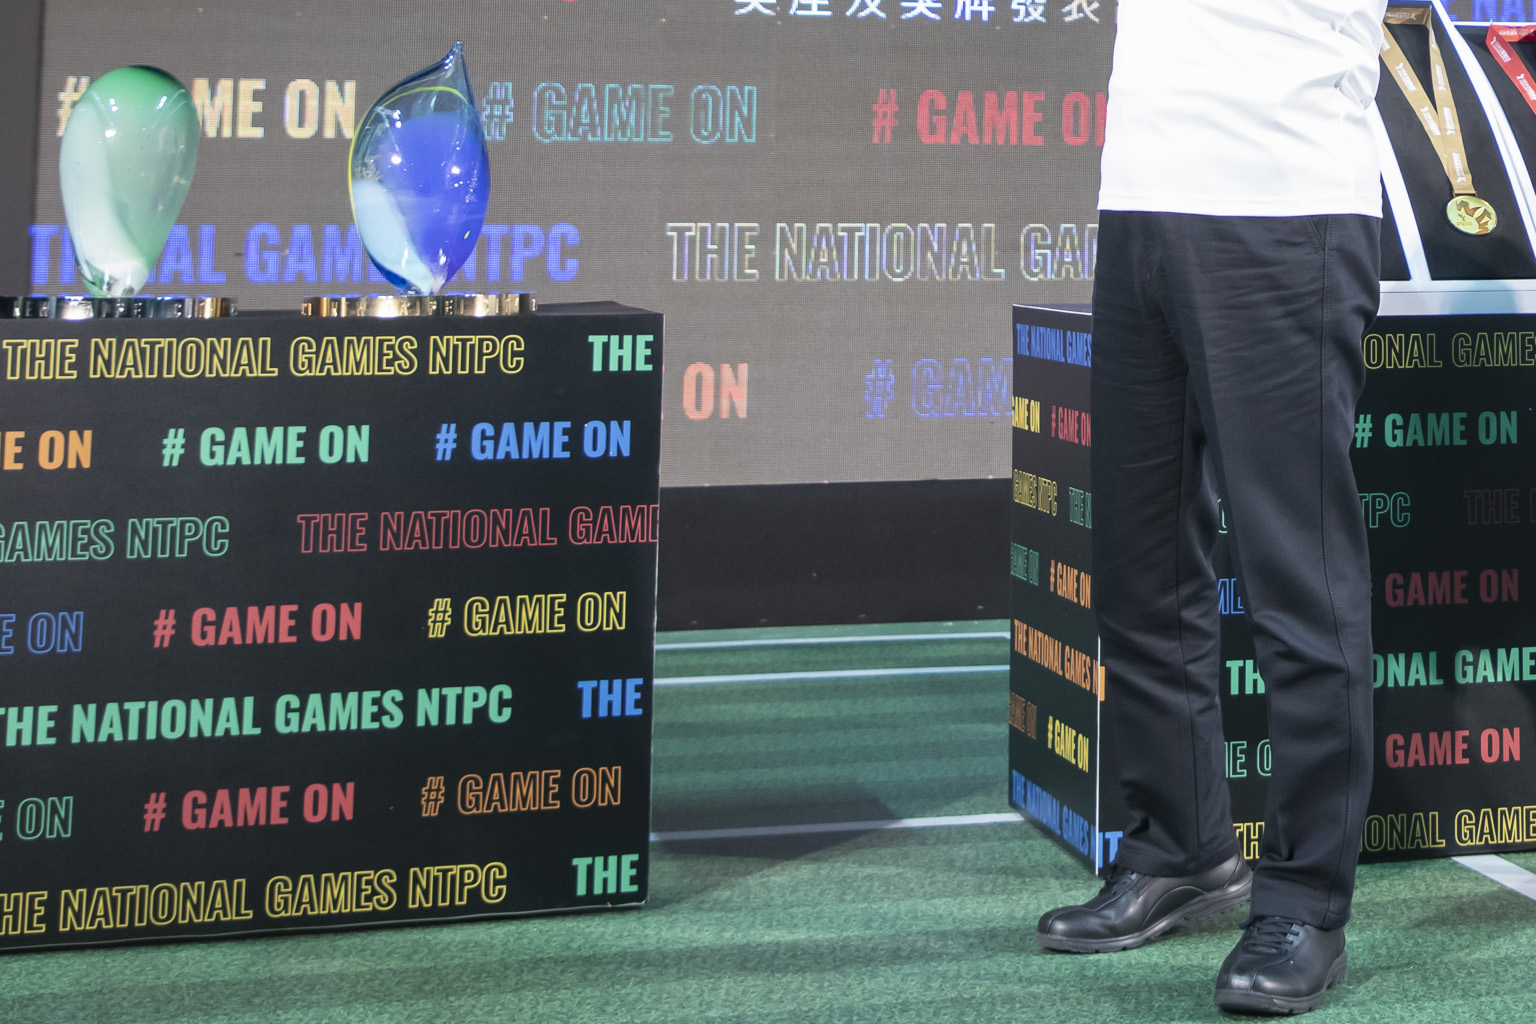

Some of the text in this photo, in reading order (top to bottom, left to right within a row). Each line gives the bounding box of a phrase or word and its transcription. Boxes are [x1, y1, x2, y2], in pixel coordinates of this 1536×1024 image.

[284, 79, 356, 139] ON
[532, 81, 757, 145] GAME ON
[917, 90, 1044, 147] GAME
[666, 223, 1005, 284] THE NATIONAL
[3, 334, 525, 380] THE NATIONAL GAMES NTPC
[589, 334, 654, 372] THE
[1016, 323, 1031, 358] THE
[1032, 325, 1065, 364] NATIONAL
[683, 361, 749, 420] ON
[200, 425, 370, 466] GAME ON
[471, 420, 632, 460] GAME ON
[1385, 409, 1518, 448] GAME ON
[298, 513, 367, 553] THE
[380, 507, 557, 551] NATIONAL
[191, 602, 363, 646] GAME ON
[464, 591, 626, 636] GAME ON
[71, 685, 512, 743] NATIONAL GAMES NTPC
[1386, 726, 1521, 768] GAME ON
[182, 782, 355, 829] GAME ON
[59, 862, 507, 932] NATIONAL GAMES NTPC
[573, 853, 639, 897] THE
